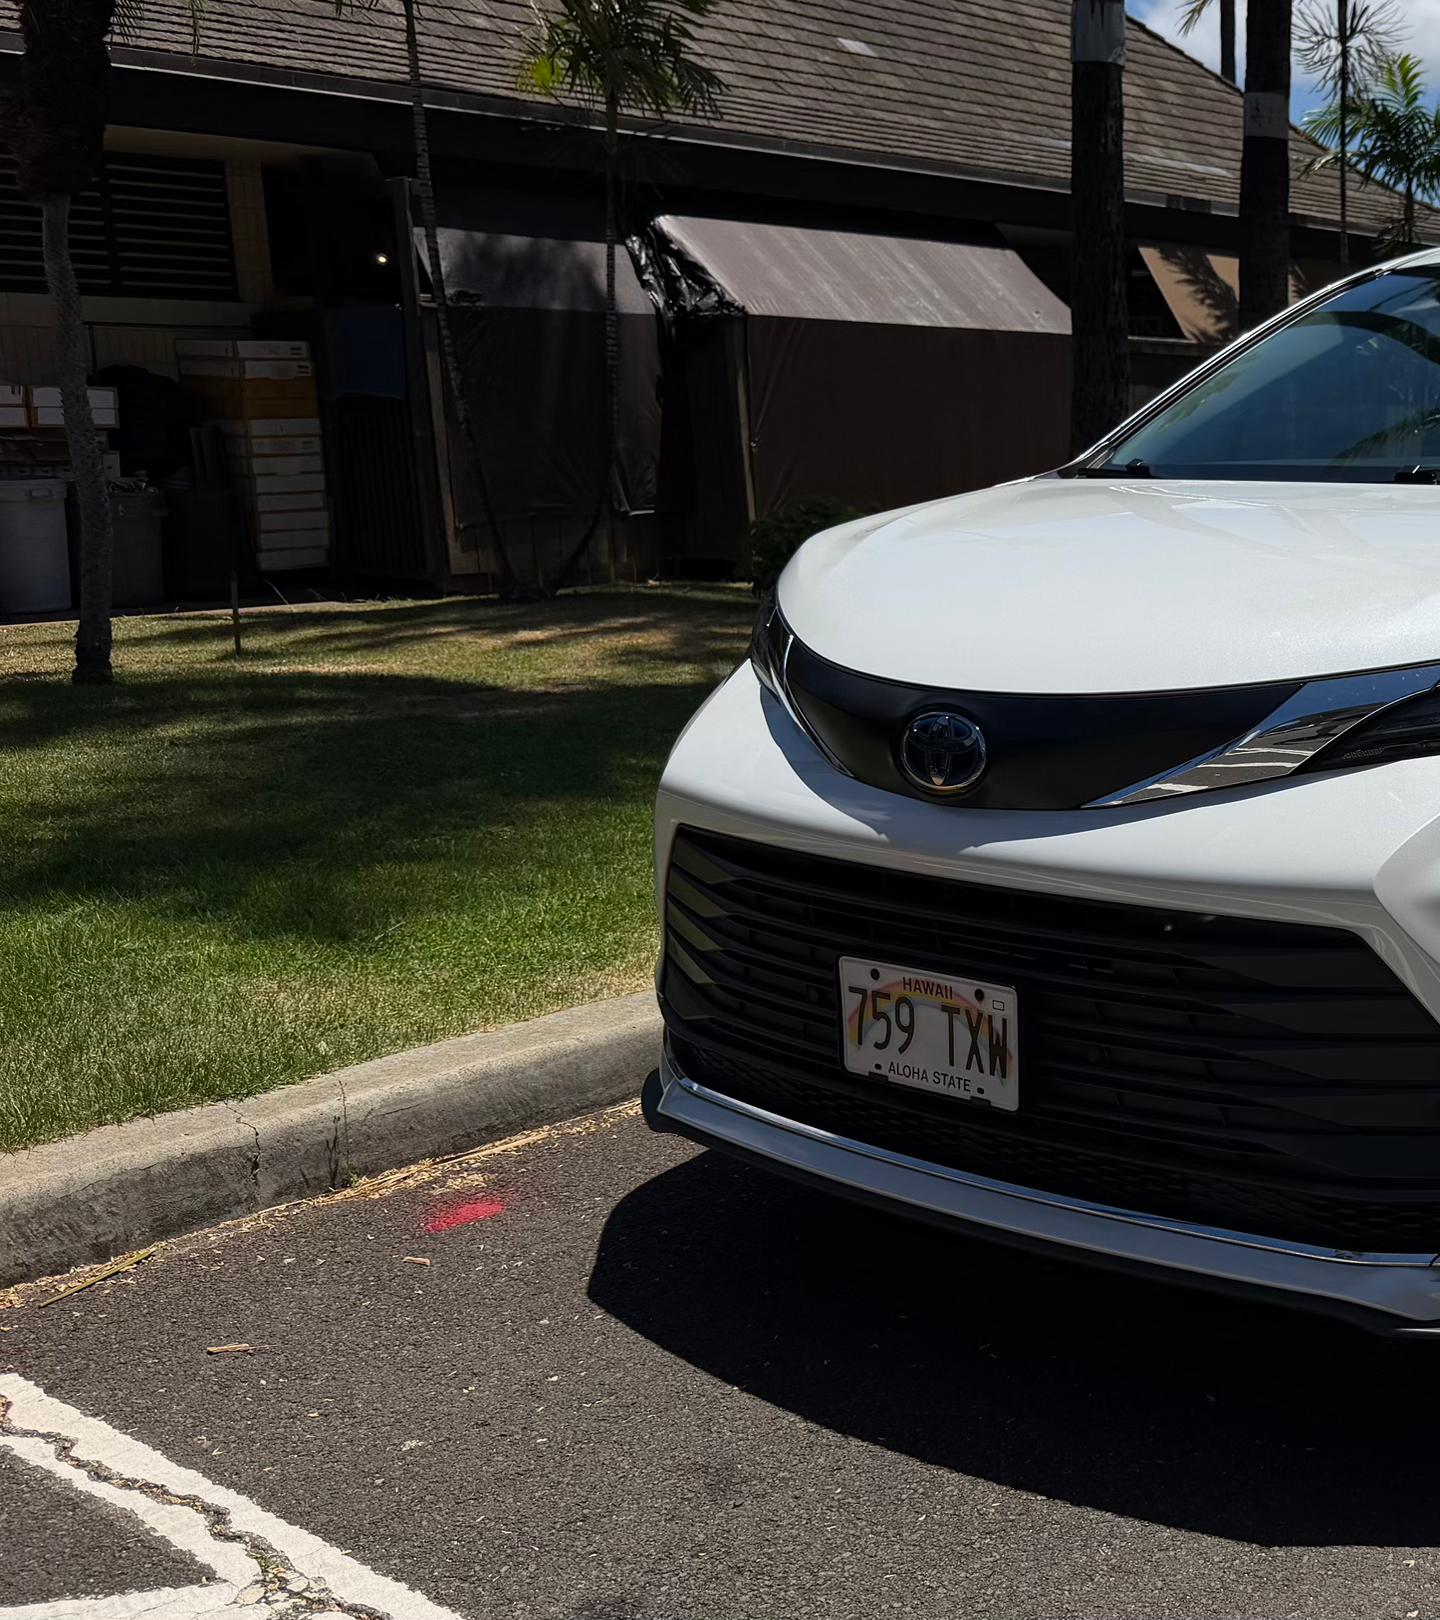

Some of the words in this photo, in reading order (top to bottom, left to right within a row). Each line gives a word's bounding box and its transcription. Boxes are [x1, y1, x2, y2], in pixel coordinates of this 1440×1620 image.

[902, 976, 953, 1000] HAWAII
[848, 985, 915, 1055] 759
[940, 1004, 1008, 1079] TXW
[888, 1061, 929, 1083] ALOHA
[932, 1070, 972, 1093] STATE
